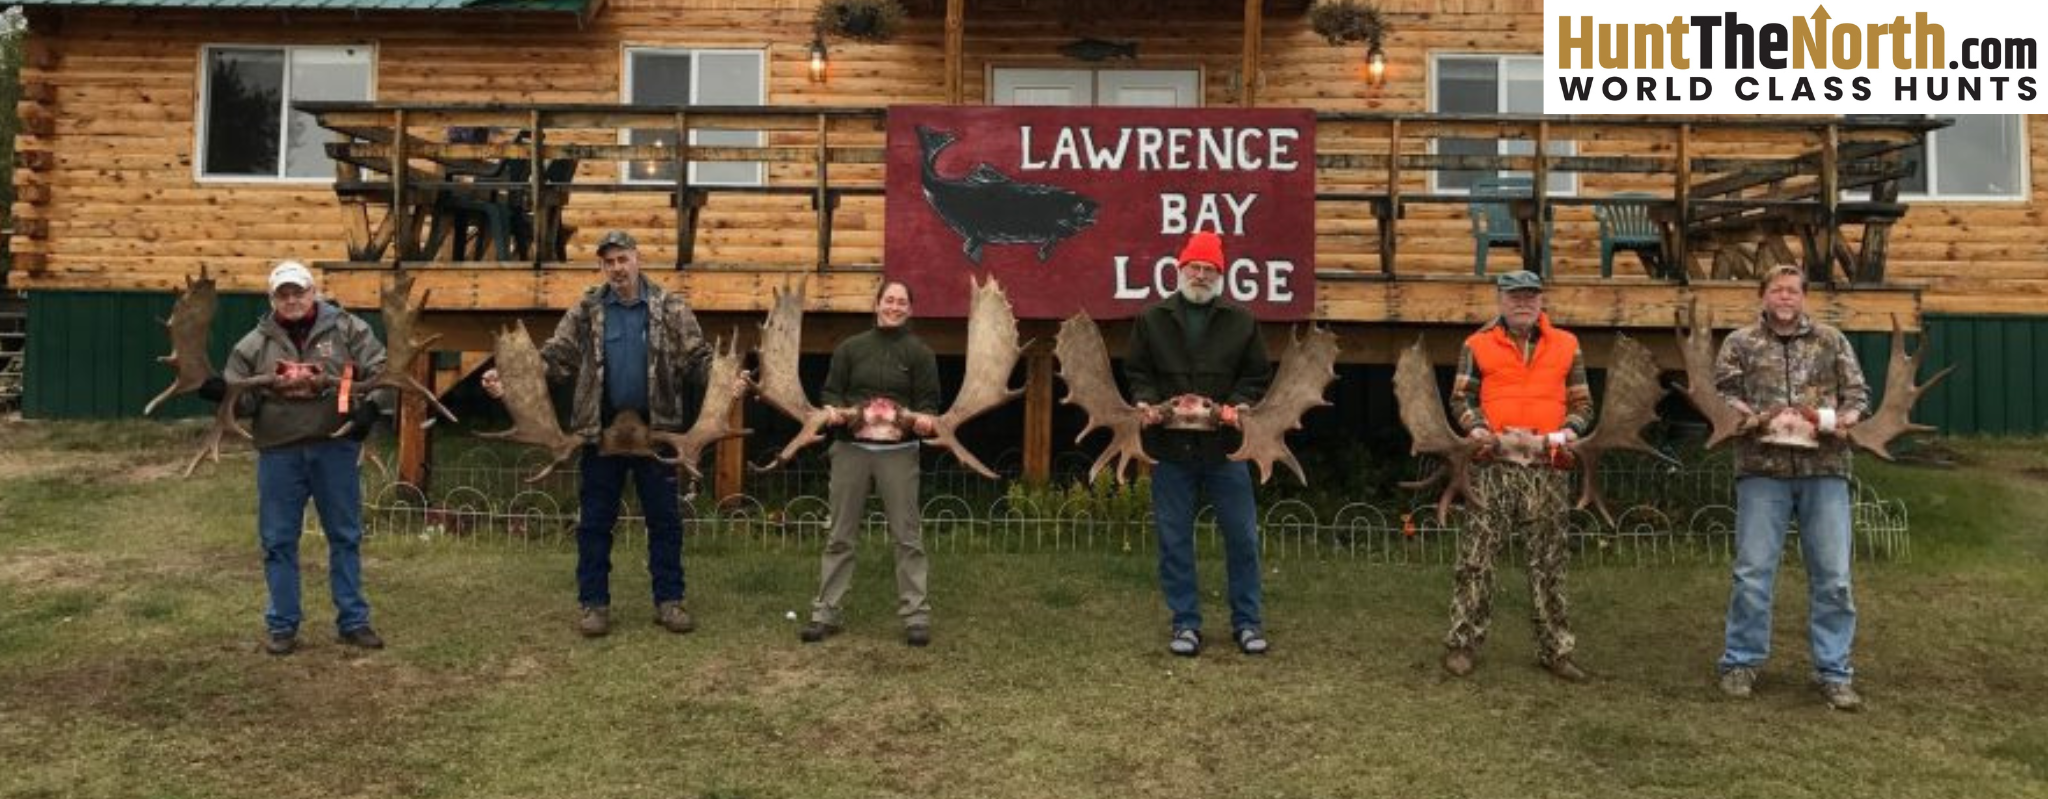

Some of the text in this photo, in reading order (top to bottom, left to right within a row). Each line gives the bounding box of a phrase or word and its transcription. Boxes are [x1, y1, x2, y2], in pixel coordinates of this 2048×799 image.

[1020, 125, 1299, 171] LAWRENCE
[1160, 193, 1258, 235] BAY
[1113, 255, 1294, 302] LOGE
